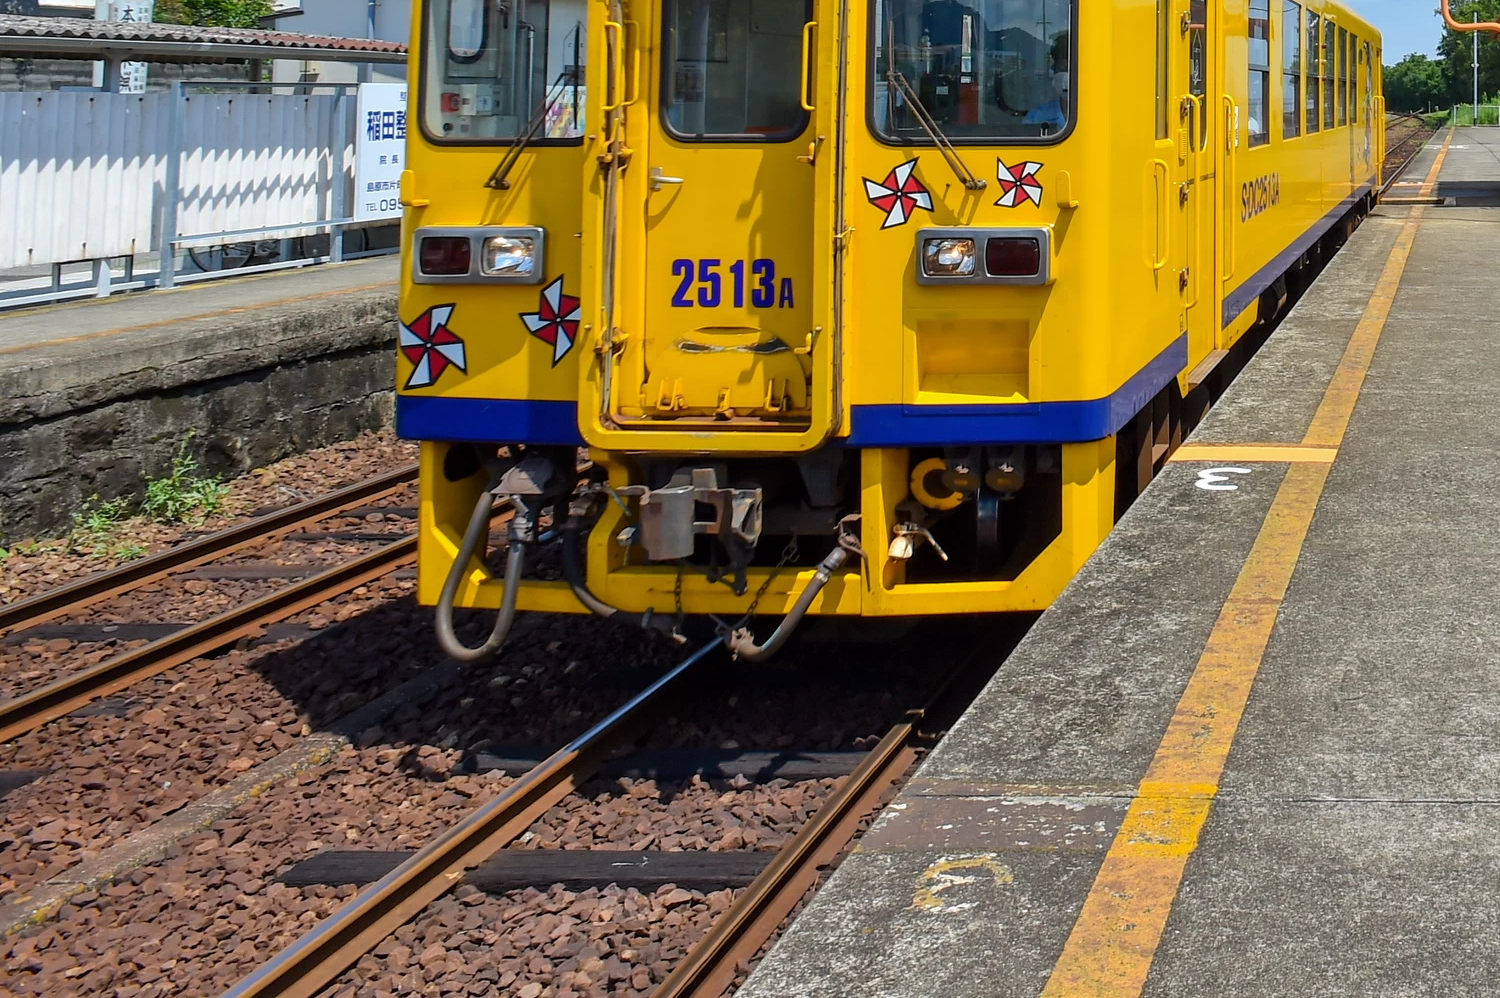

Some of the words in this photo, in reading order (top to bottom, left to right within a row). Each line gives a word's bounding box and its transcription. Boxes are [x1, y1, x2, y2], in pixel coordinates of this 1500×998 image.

[365, 202, 379, 212] TEL
[1240, 172, 1280, 224] SDC2513A
[1194, 466, 1252, 491] 3
